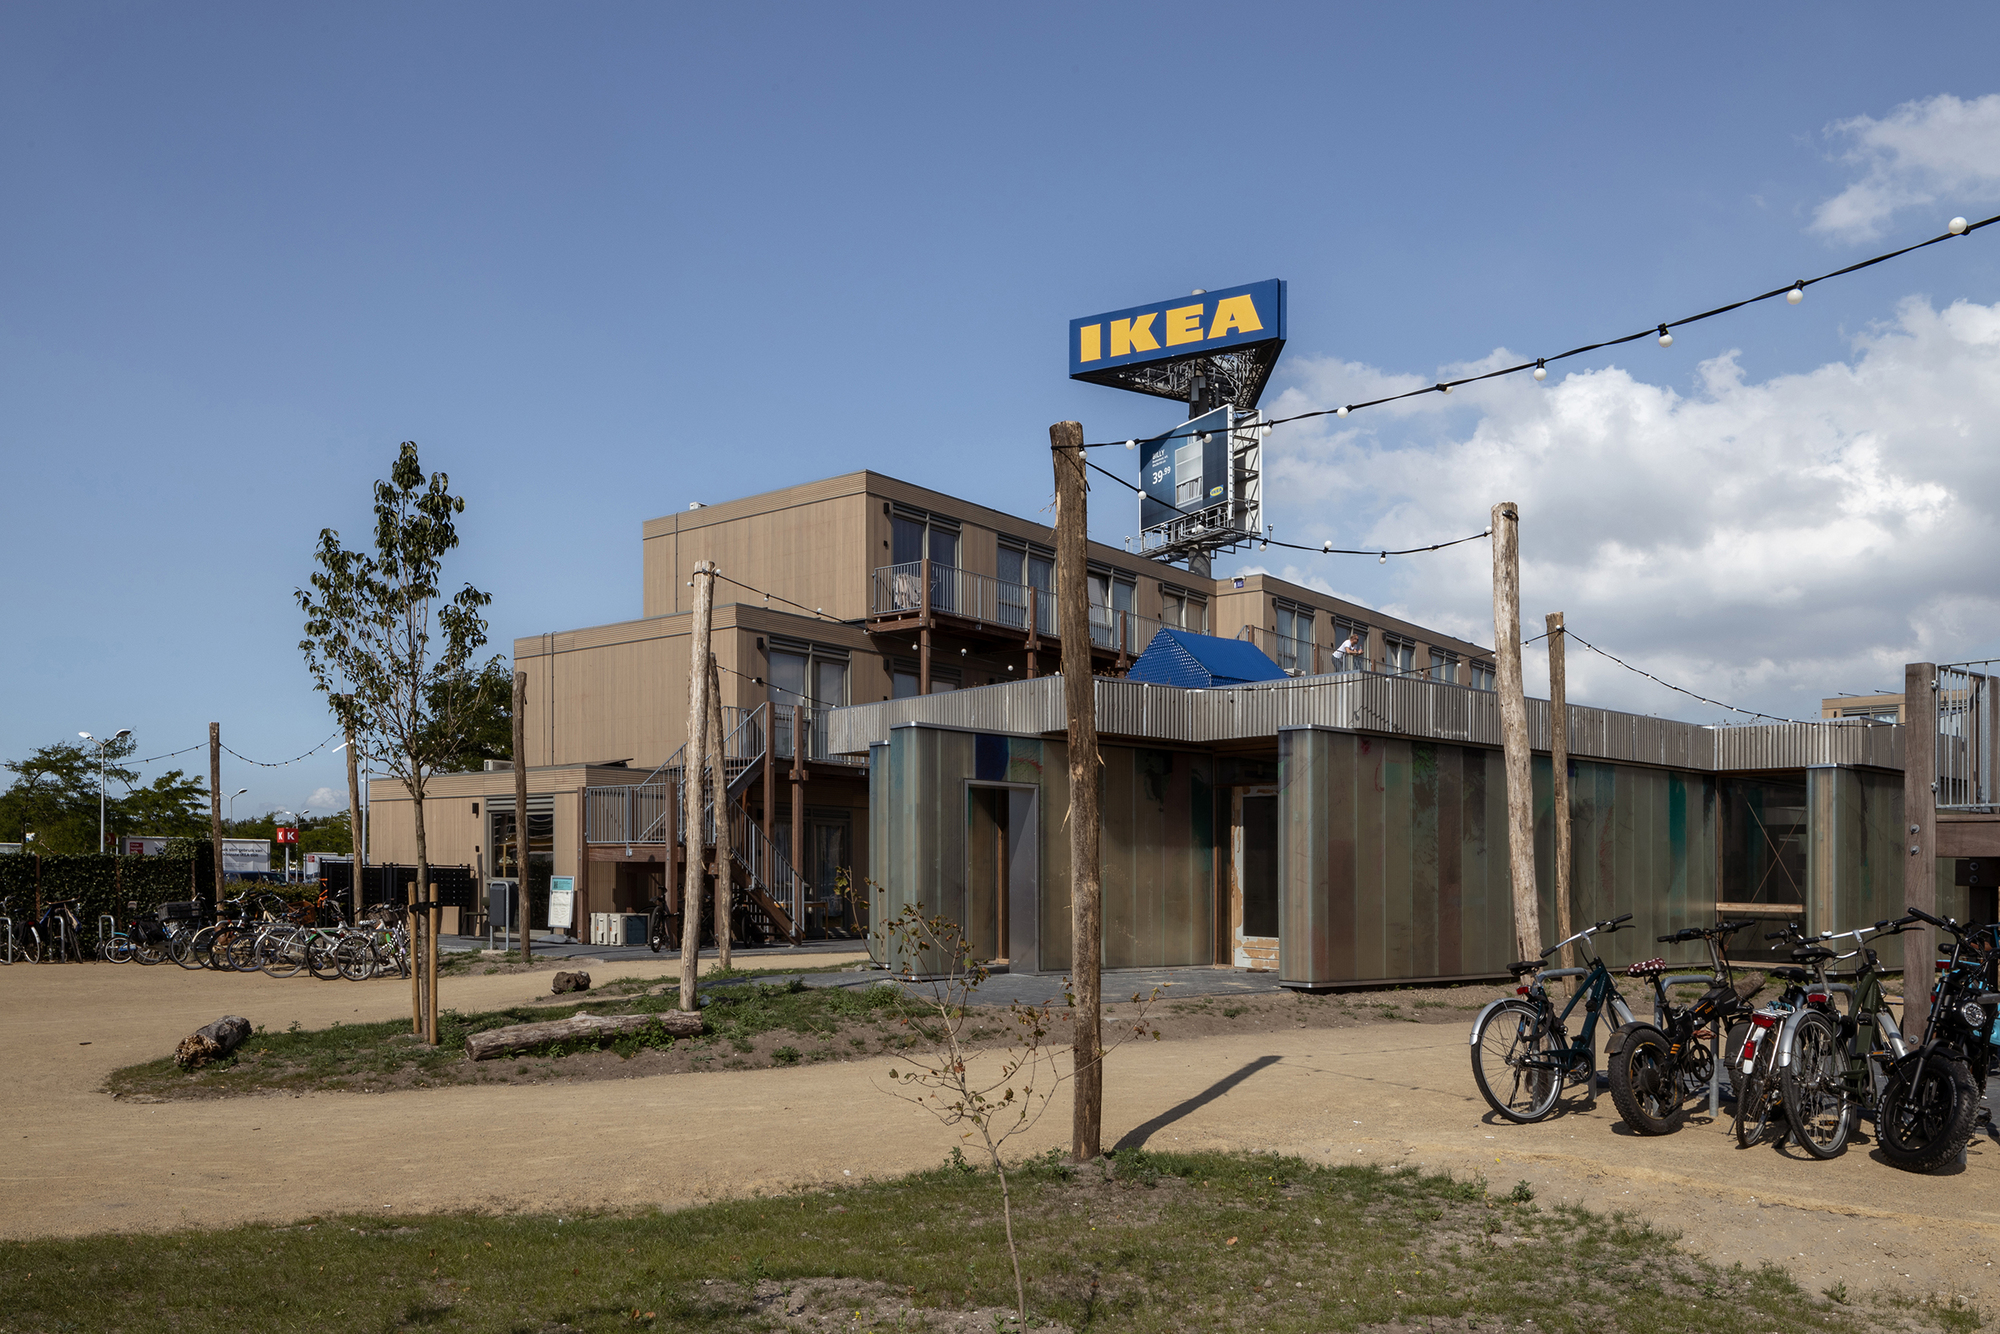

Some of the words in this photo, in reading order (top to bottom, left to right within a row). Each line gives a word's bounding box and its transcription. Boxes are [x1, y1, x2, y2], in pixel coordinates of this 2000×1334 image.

[1080, 294, 1264, 363] IKEA
[1152, 466, 1171, 485] 39.99
[278, 831, 283, 840] K
[287, 831, 295, 840] K
[1876, 1095, 1887, 1140] KENDA
